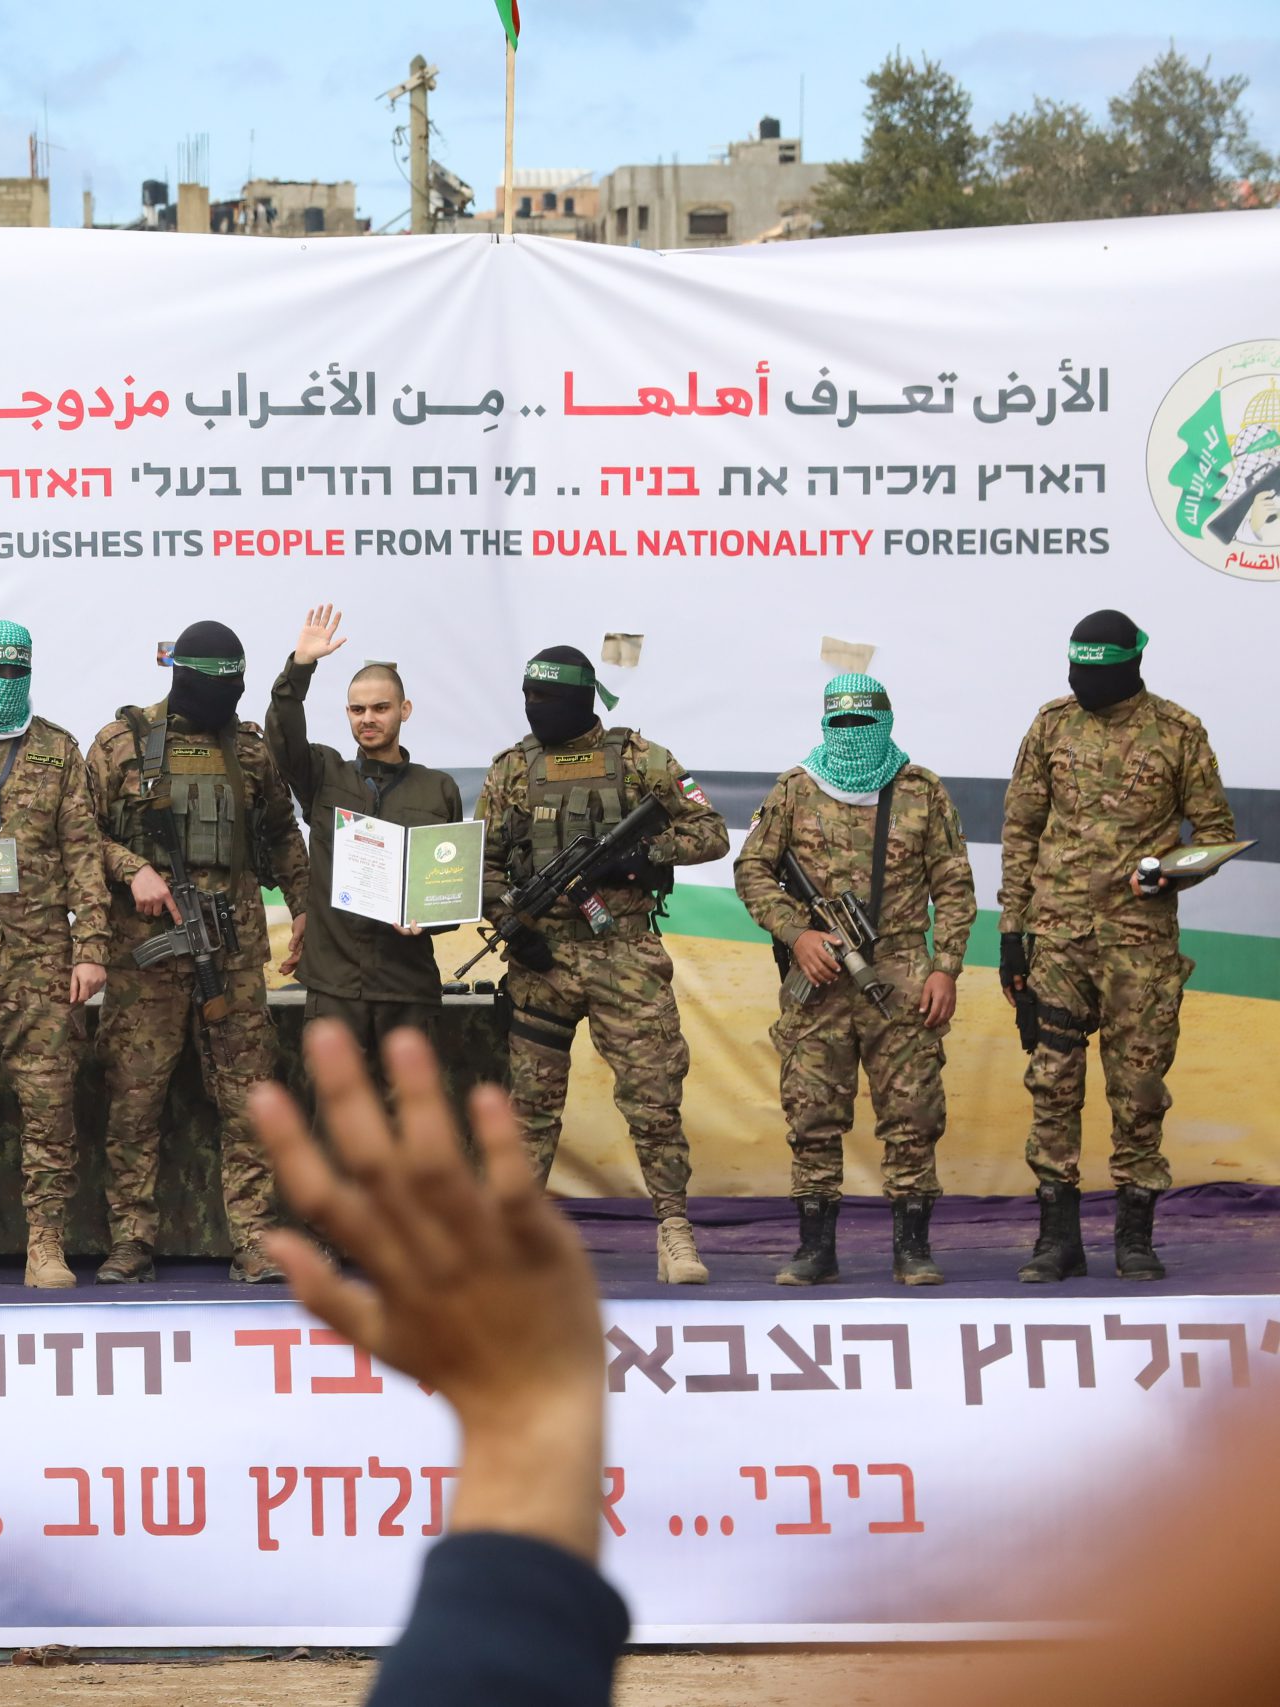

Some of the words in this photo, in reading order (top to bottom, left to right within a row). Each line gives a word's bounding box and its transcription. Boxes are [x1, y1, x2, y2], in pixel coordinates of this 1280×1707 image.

[187, 364, 376, 430] الأغراب
[565, 362, 771, 418] أهلها
[786, 368, 959, 429] تعرف
[974, 360, 1109, 427] الأرض
[133, 464, 243, 498] בעלי
[263, 467, 393, 497] הזרים
[413, 467, 478, 497] הם
[496, 467, 537, 497] מי
[602, 468, 701, 497] בניה
[720, 468, 789, 497] את
[808, 466, 957, 497] מכירה
[979, 465, 1107, 502] הארץ
[154, 531, 205, 558] ITS
[214, 531, 347, 558] PEOPLE
[356, 530, 453, 557] FROM
[461, 531, 524, 557] THE
[533, 530, 628, 558] DUAL
[638, 530, 875, 558] NATIONALITY
[885, 529, 1111, 557] FOREIGNERS
[1225, 550, 1280, 570] القسام
[606, 1324, 913, 1395] הצבא
[44, 1467, 207, 1537] שוב
